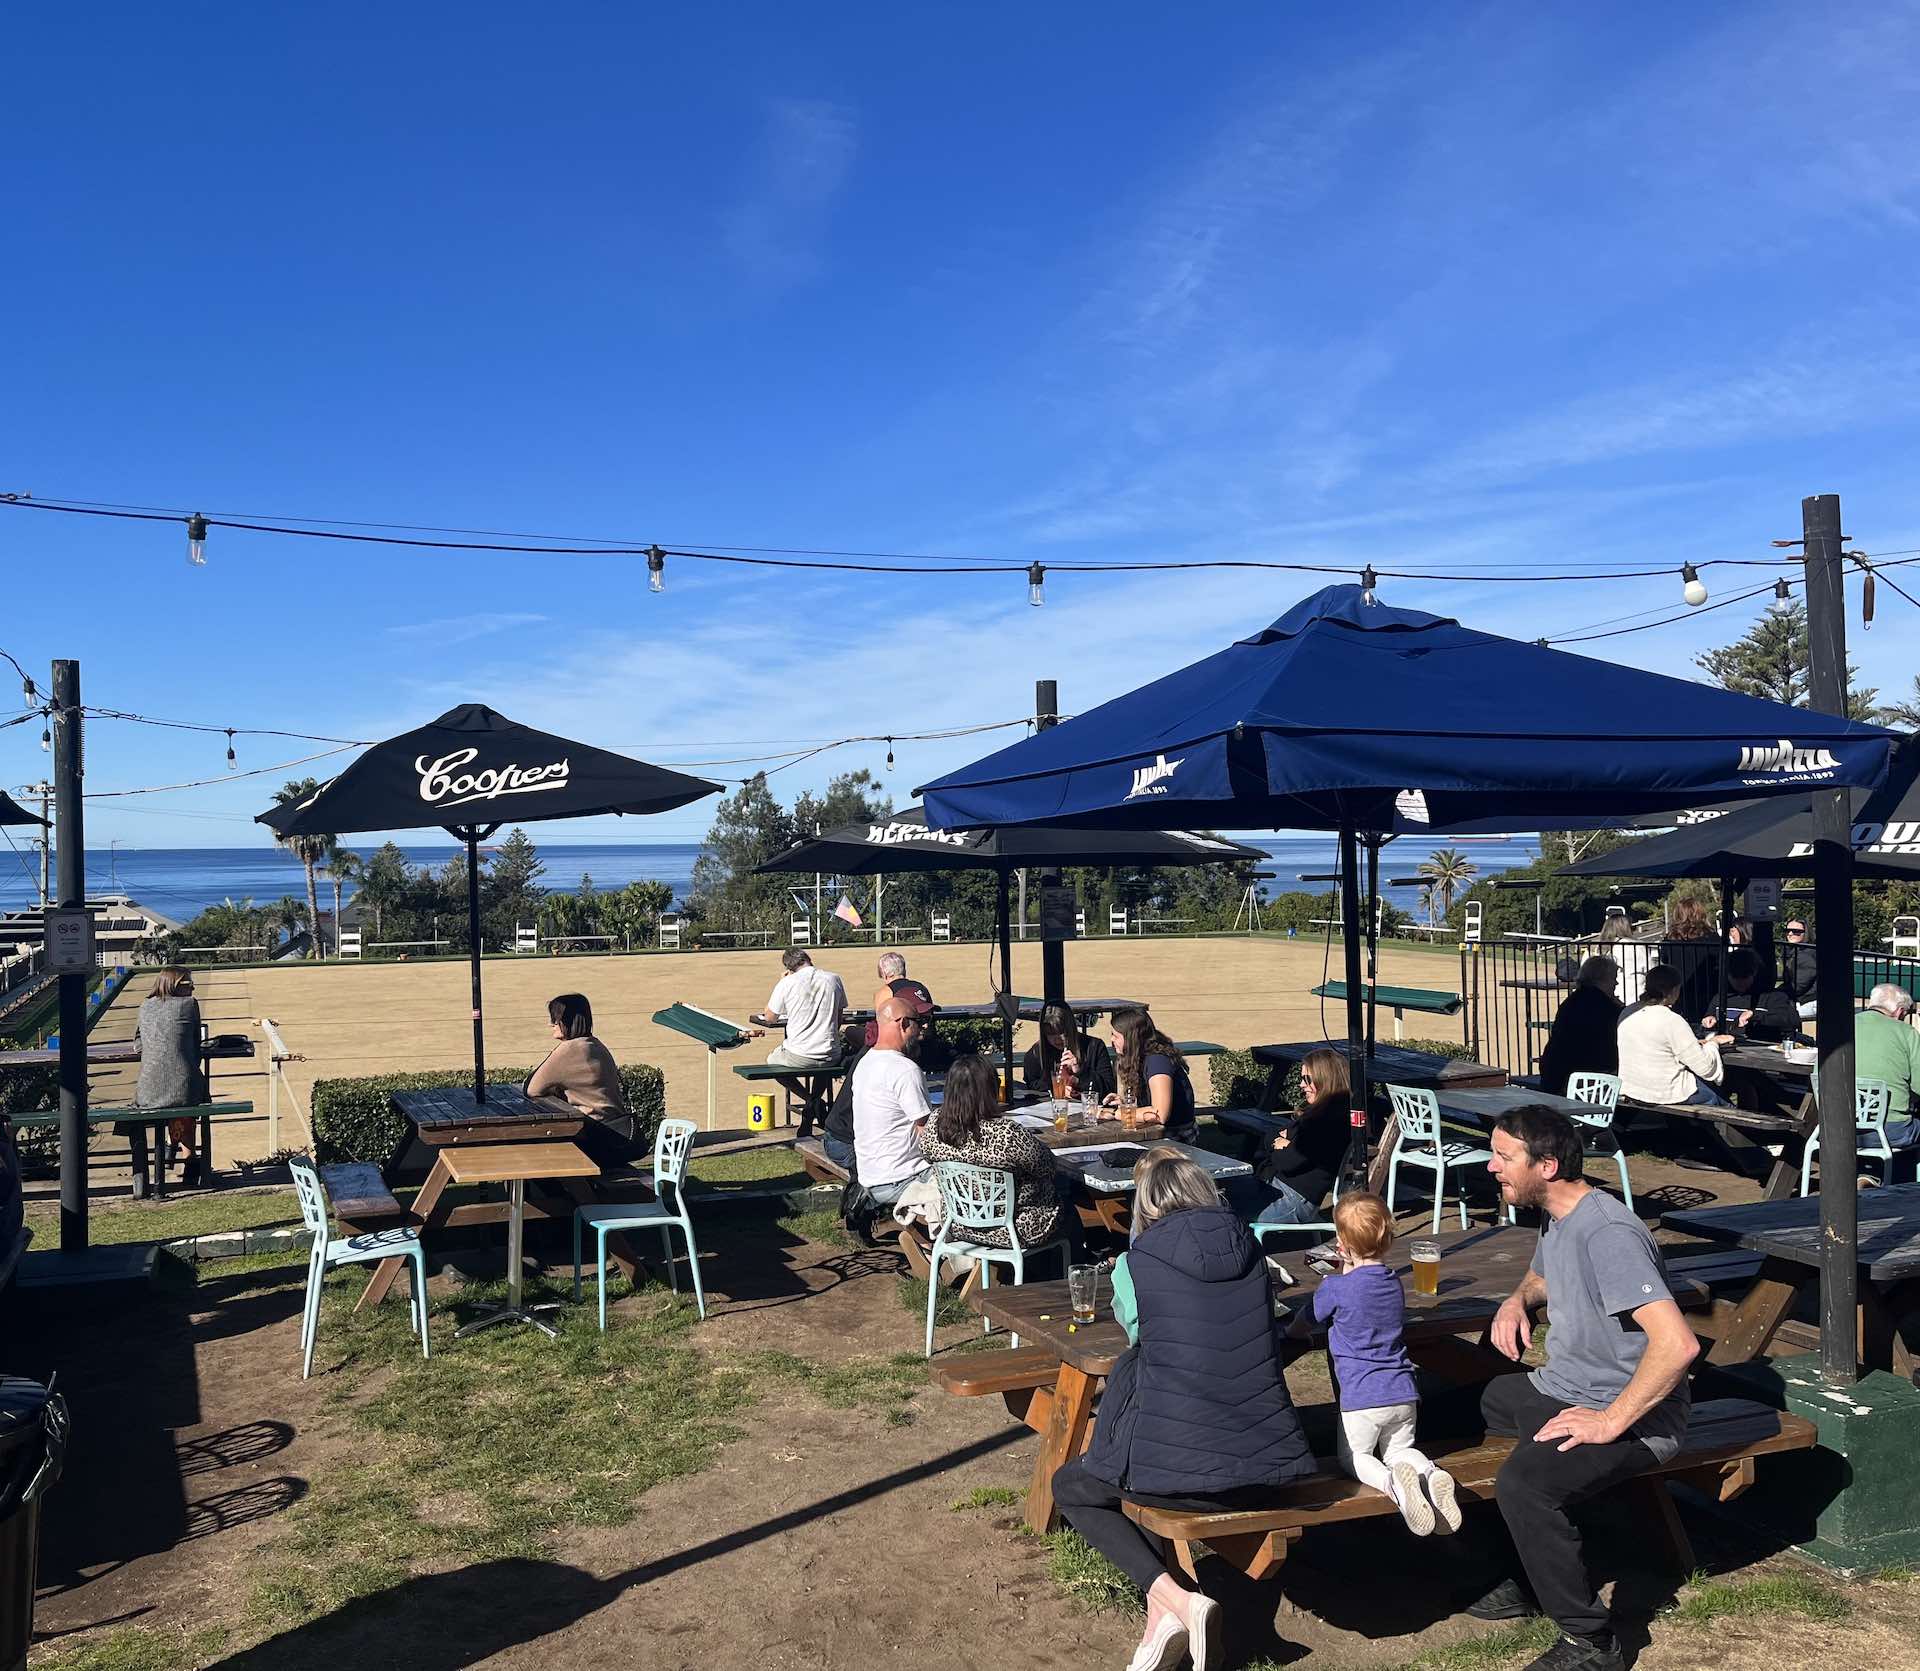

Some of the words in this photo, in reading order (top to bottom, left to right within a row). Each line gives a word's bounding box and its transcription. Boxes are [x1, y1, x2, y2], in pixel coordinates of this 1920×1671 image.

[1737, 739, 1842, 772] LAVAZZA
[415, 748, 569, 803] Coopers
[1850, 822, 1920, 844] OU
[753, 1105, 763, 1123] 8
